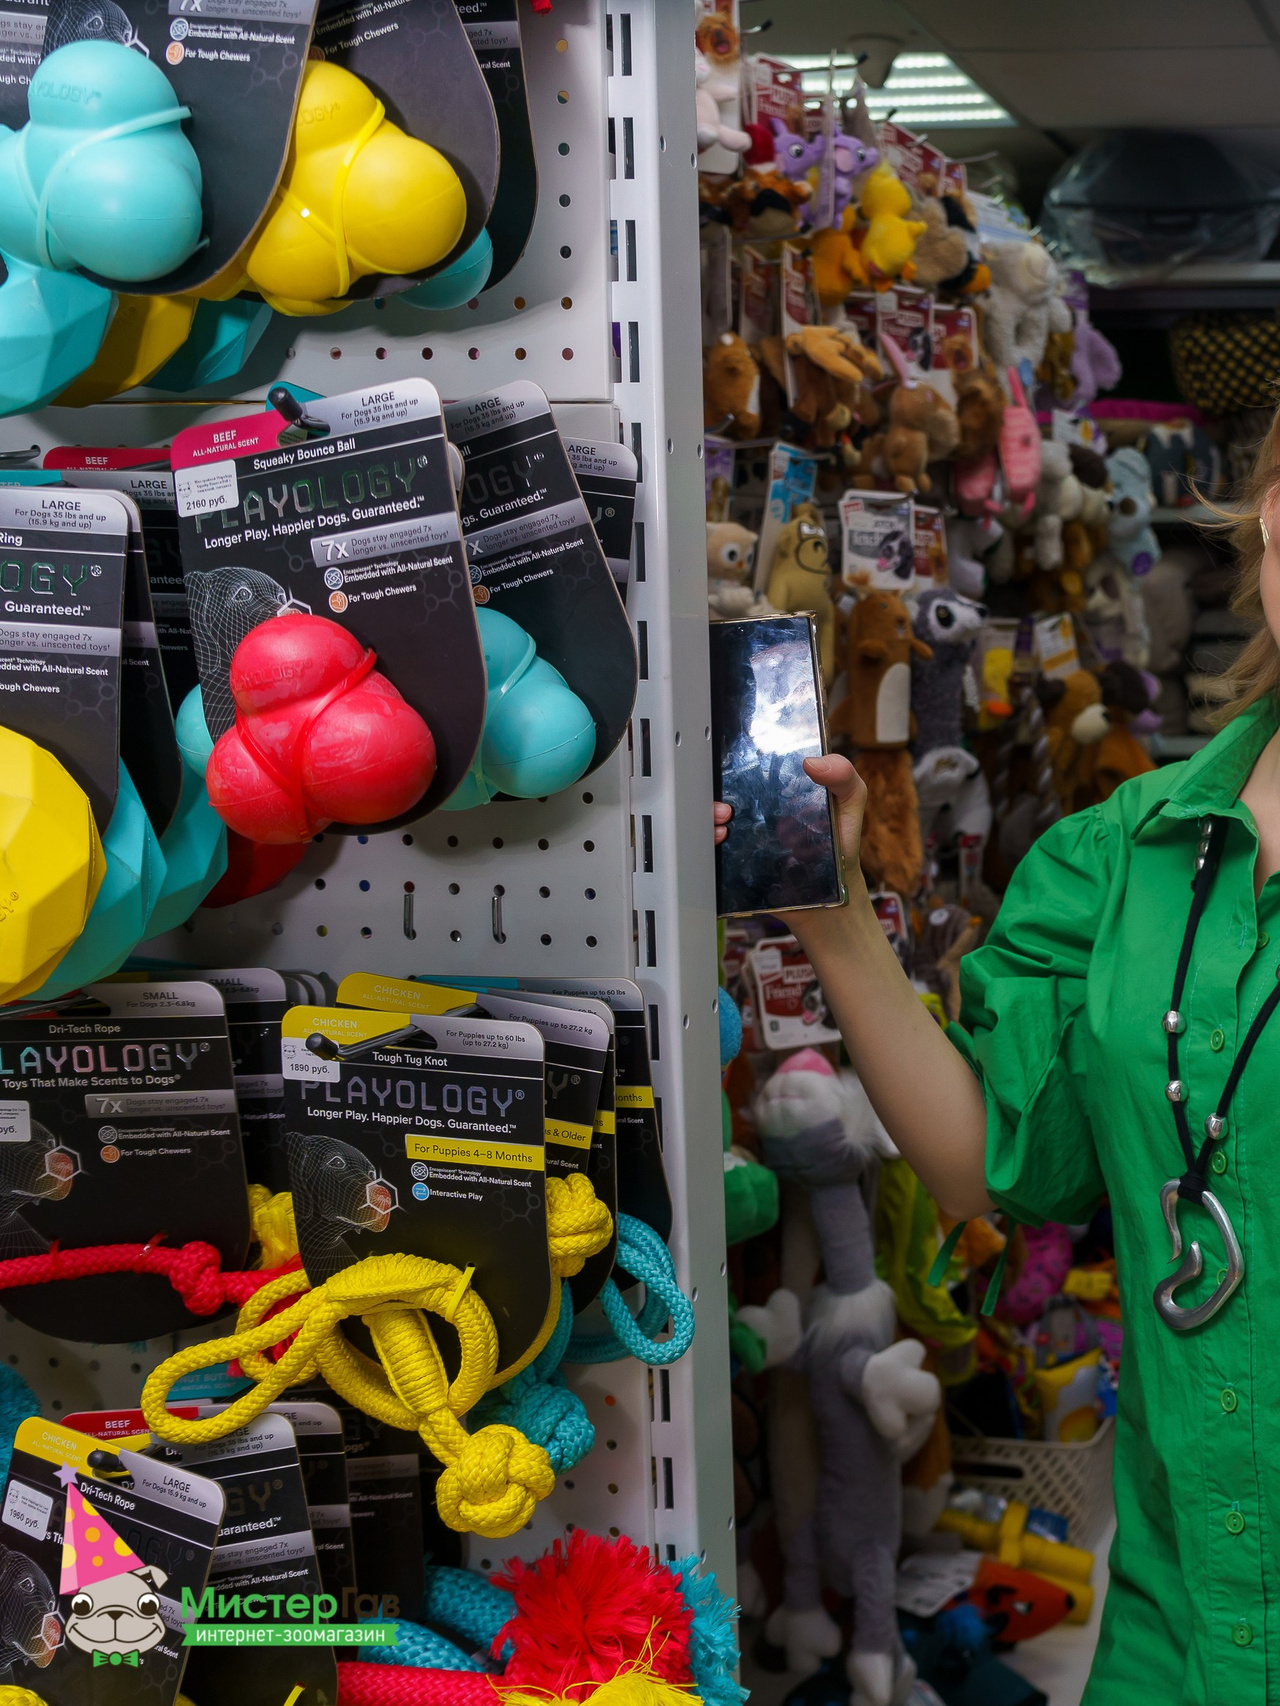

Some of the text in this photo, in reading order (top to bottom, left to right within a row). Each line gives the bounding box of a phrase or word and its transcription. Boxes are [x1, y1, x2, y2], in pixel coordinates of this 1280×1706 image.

[188, 29, 295, 45] Embedded with All-Natural Scent
[325, 22, 399, 55] For Tough Chewers
[185, 50, 250, 62] For Tough Chewers
[492, 61, 510, 69] Scent
[362, 392, 395, 406] LARGE
[468, 397, 501, 415] LARGE
[341, 398, 418, 420] For Dogs 35 lbs and up
[213, 430, 237, 443] BEEF
[192, 437, 259, 457] ALL-NATURAL SCENT
[253, 438, 356, 470] Squeaky Bounce Ball
[85, 457, 108, 465] BEEF
[131, 480, 167, 489] LARGE
[42, 500, 81, 511] LARGE
[186, 495, 227, 511] 2160 руб.
[30, 510, 52, 519] Dogs
[28, 518, 48, 526] (15.9
[50, 519, 59, 528] kg
[79, 521, 92, 529] up)
[205, 531, 242, 549] Longer
[244, 526, 271, 543] Play.
[272, 518, 315, 537] Happier
[318, 513, 349, 529] Dogs.
[351, 525, 432, 548] Dogs stay engaged 7x
[321, 540, 349, 561] 7x
[344, 570, 380, 583] Embedded
[381, 568, 396, 576] with
[397, 561, 432, 573] All-Natural
[434, 556, 453, 566] Scent
[348, 584, 417, 603] For Tough Chewers
[22, 631, 92, 642] stay engaged 7x
[42, 665, 84, 675] All-Natural
[86, 667, 109, 676] Scent
[22, 683, 60, 693] Chewers
[143, 992, 179, 1000] SMALL
[374, 984, 421, 1000] CHICKEN
[140, 1001, 158, 1009] Dogs
[49, 1024, 121, 1036] Dri-Tech Rope
[312, 1017, 358, 1029] CHICKEN
[509, 1013, 520, 1021] For
[522, 1016, 549, 1027] Puppies
[550, 1020, 560, 1029] up
[569, 1024, 583, 1033] 27.2
[584, 1027, 593, 1035] kg
[458, 1031, 486, 1042] Puppies
[487, 1034, 496, 1042] up
[505, 1034, 514, 1042] 60
[372, 1051, 448, 1067] Tough Tug Knot
[290, 1063, 330, 1075] 1890 руб.
[2, 1079, 28, 1090] Toys
[30, 1079, 56, 1088] That
[58, 1078, 88, 1087] Make
[91, 1076, 128, 1087] Scents
[131, 1076, 142, 1086] to
[96, 1097, 123, 1114] 7x
[307, 1106, 343, 1120] Longer
[345, 1110, 370, 1122] Play.
[372, 1112, 412, 1126] Happier
[415, 1116, 445, 1129] Dogs.
[562, 1131, 586, 1142] Older
[135, 1148, 156, 1158] Tough
[156, 1147, 191, 1155] Chewers
[414, 1143, 430, 1154] For
[432, 1145, 471, 1159] Puppies
[495, 1151, 533, 1163] Months
[429, 1171, 461, 1181] Embedded
[463, 1173, 477, 1182] with
[478, 1175, 512, 1185] All-Natural
[513, 1178, 532, 1187] Scent
[430, 1189, 483, 1202] Interactive Play
[105, 1420, 131, 1429] BEEF
[41, 1432, 77, 1451] CHICKEN
[163, 1476, 191, 1493] LARGE
[80, 1483, 136, 1511] Dri-Tech Rope
[251, 1568, 308, 1585] All-Natural Scent
